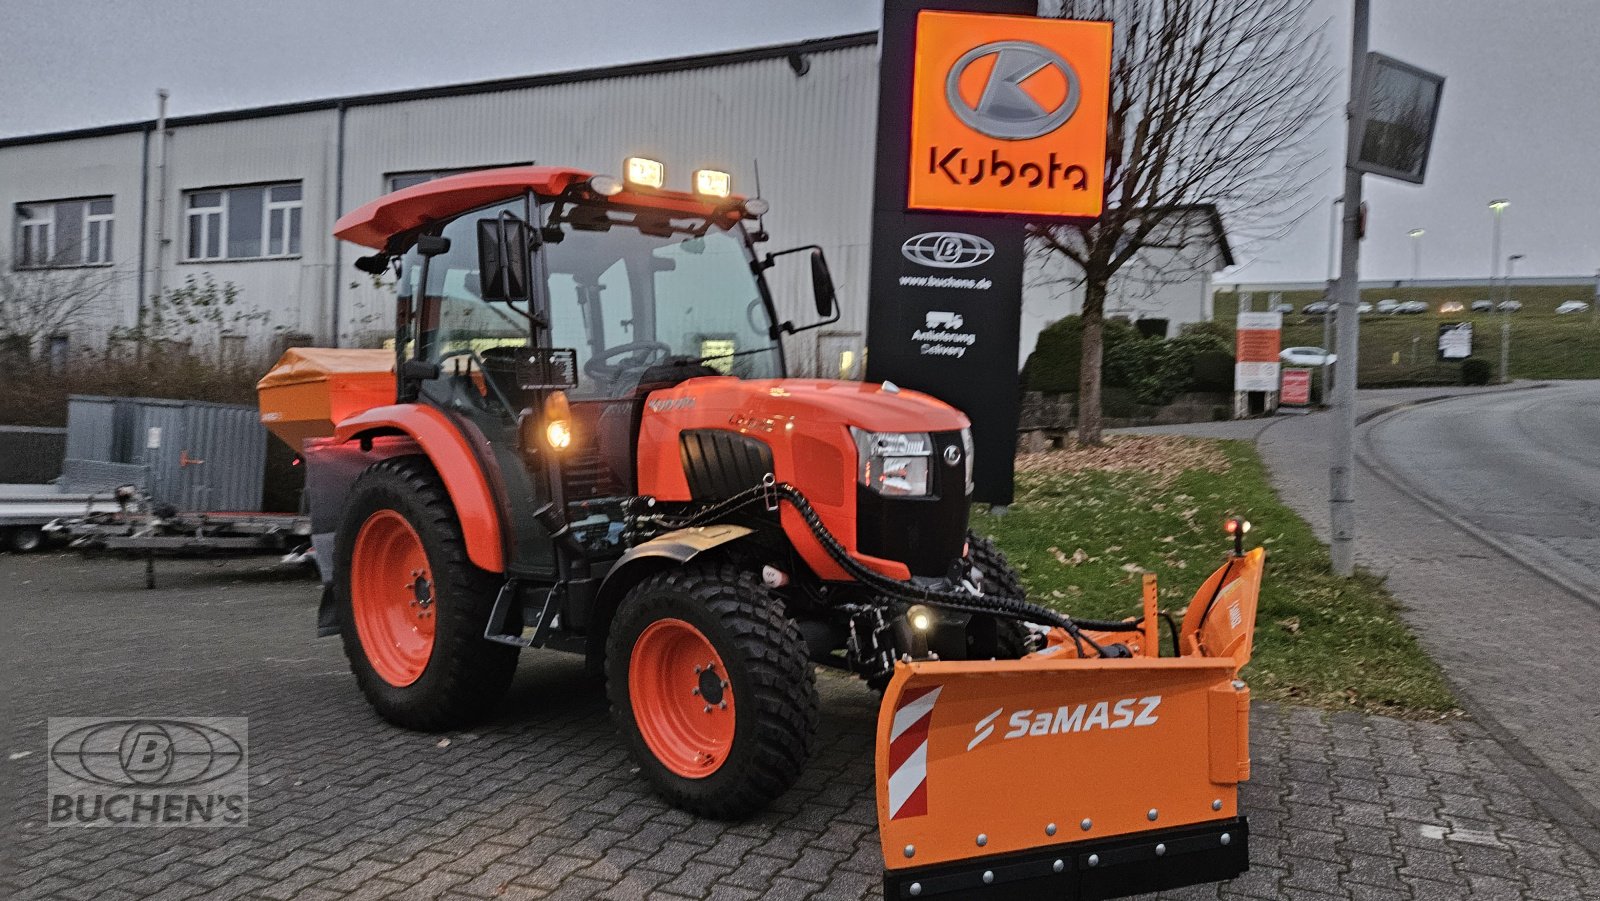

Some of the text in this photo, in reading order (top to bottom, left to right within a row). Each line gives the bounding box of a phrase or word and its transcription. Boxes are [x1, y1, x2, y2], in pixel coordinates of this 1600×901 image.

[929, 146, 1088, 191] Kubota
[899, 275, 993, 290] www.buchens.de
[1004, 695, 1162, 740] SaMASZ
